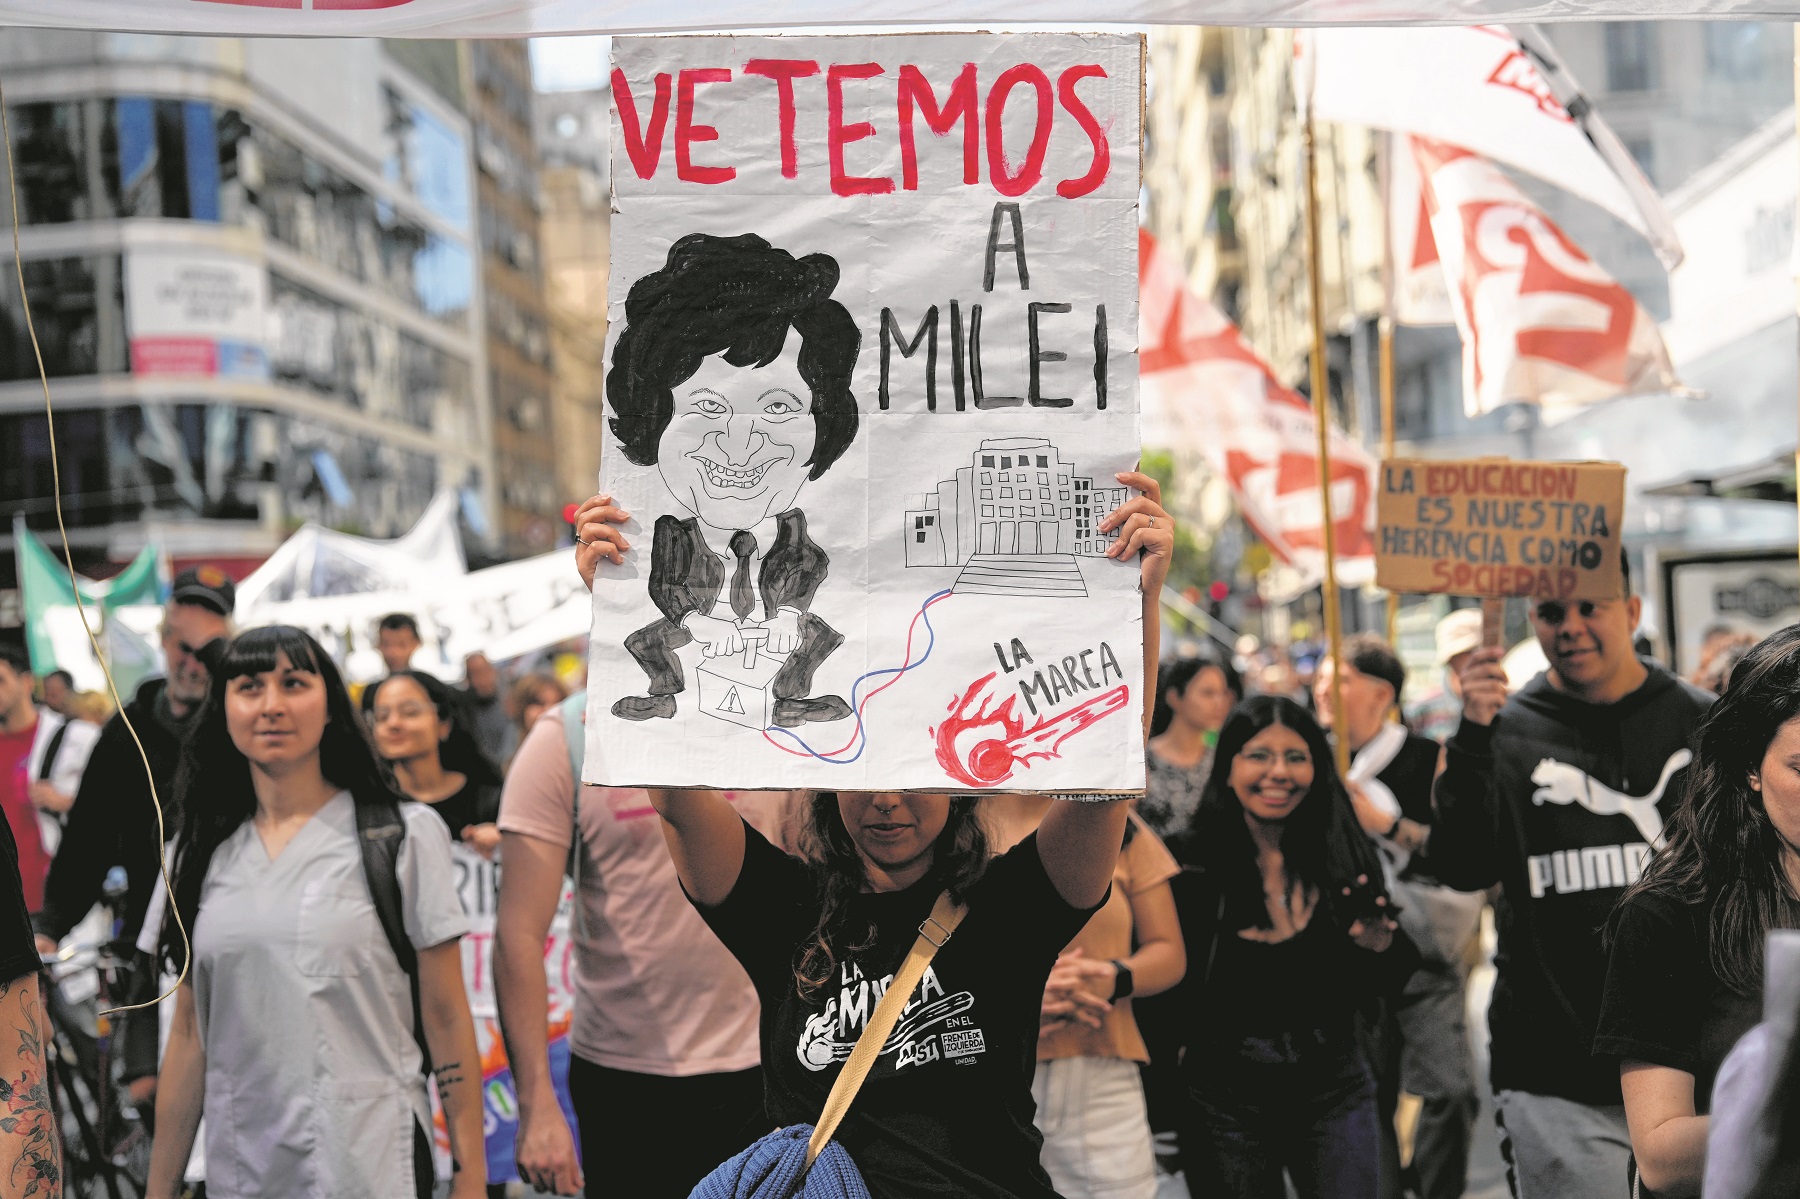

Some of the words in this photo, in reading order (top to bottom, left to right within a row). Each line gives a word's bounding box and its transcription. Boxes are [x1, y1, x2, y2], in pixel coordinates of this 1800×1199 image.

[983, 202, 1030, 292] A
[878, 300, 1108, 413] MILEI
[1386, 467, 1414, 494] LA
[1426, 465, 1577, 500] EDUCACION
[1417, 497, 1454, 525] ES
[1467, 498, 1609, 538] NUESTRA
[1381, 525, 1507, 565] HERENCIA
[1519, 536, 1603, 570] COMO
[1431, 558, 1578, 600] SOCIEDAD
[993, 637, 1034, 674] LA
[1018, 641, 1124, 716] MAREA
[841, 961, 864, 986] LA
[943, 1031, 972, 1043] FRENTE
[973, 1031, 981, 1039] DE
[946, 1017, 960, 1029] EN
[961, 1015, 974, 1026] EL
[944, 1039, 984, 1052] IZQUIERDA
